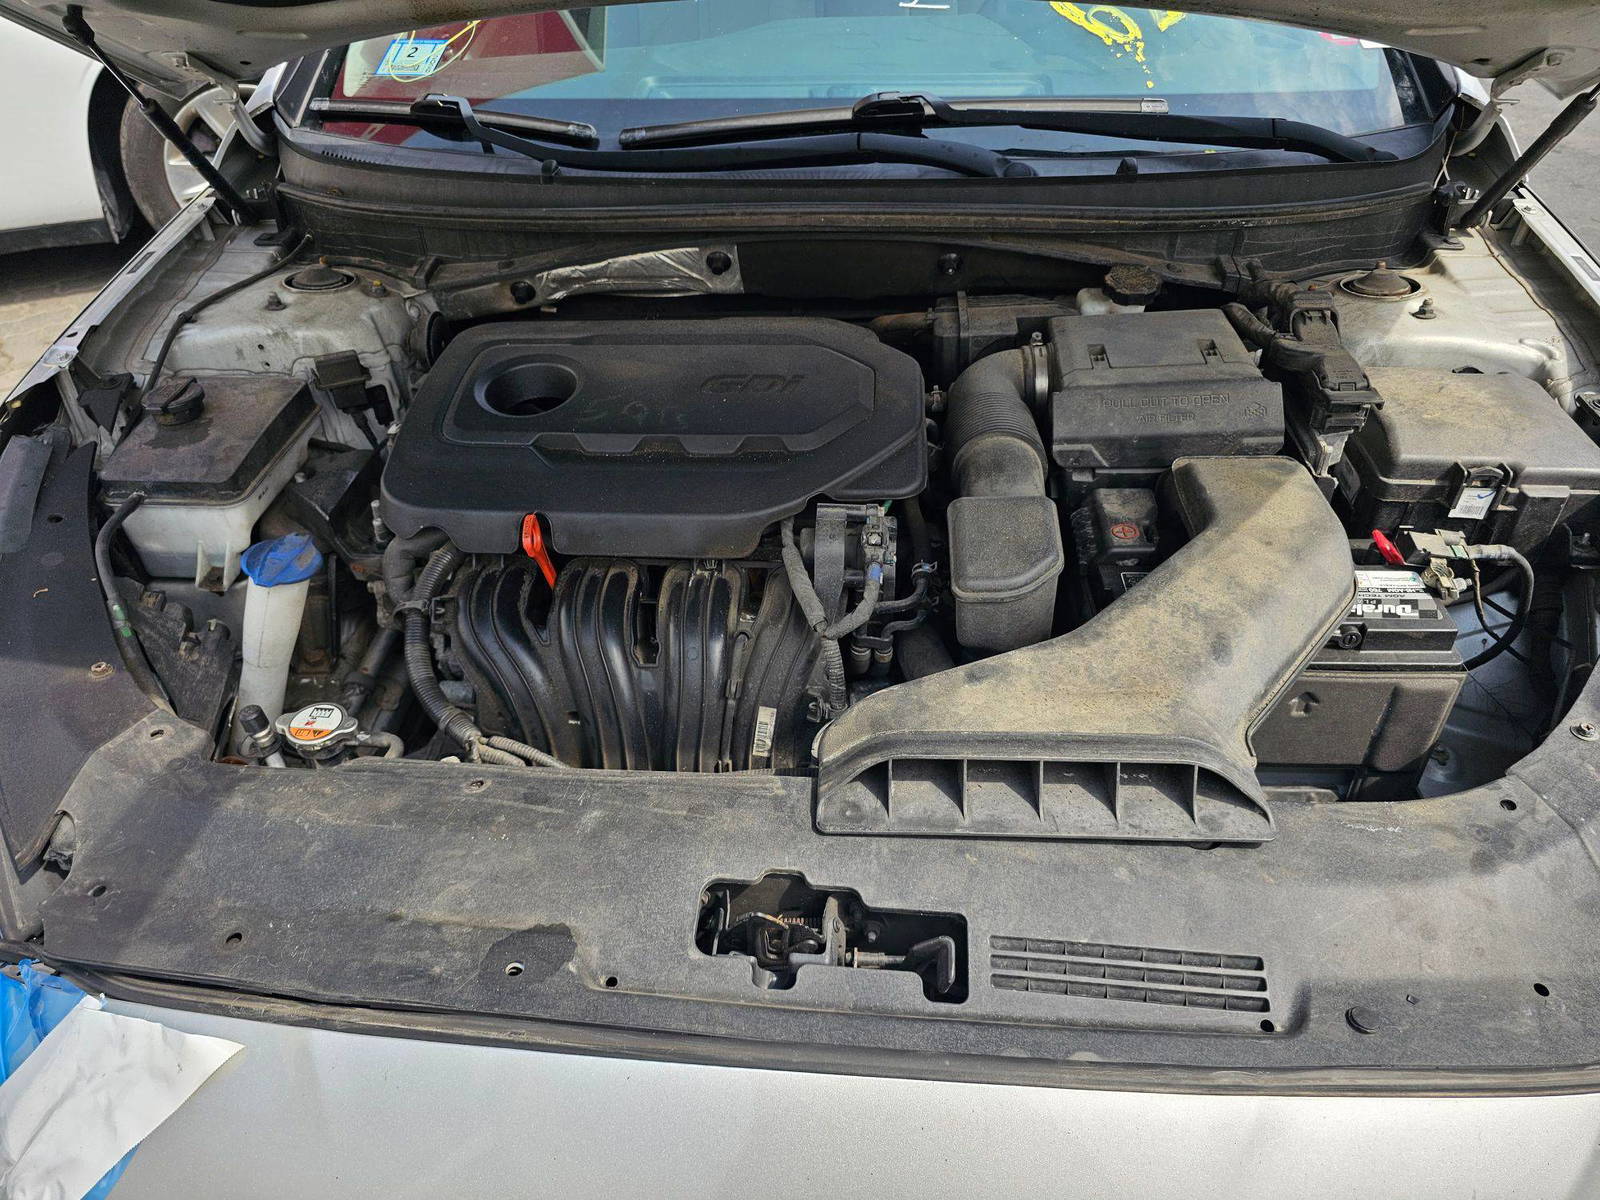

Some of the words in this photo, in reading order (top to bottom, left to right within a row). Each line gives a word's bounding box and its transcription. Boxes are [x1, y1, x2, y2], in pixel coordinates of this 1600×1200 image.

[407, 47, 418, 58] 2
[1104, 399, 1136, 409] PULL
[1140, 398, 1168, 408] OUT
[1171, 396, 1190, 407] TO
[1193, 393, 1230, 407] OPEN
[1137, 414, 1157, 424] AIR
